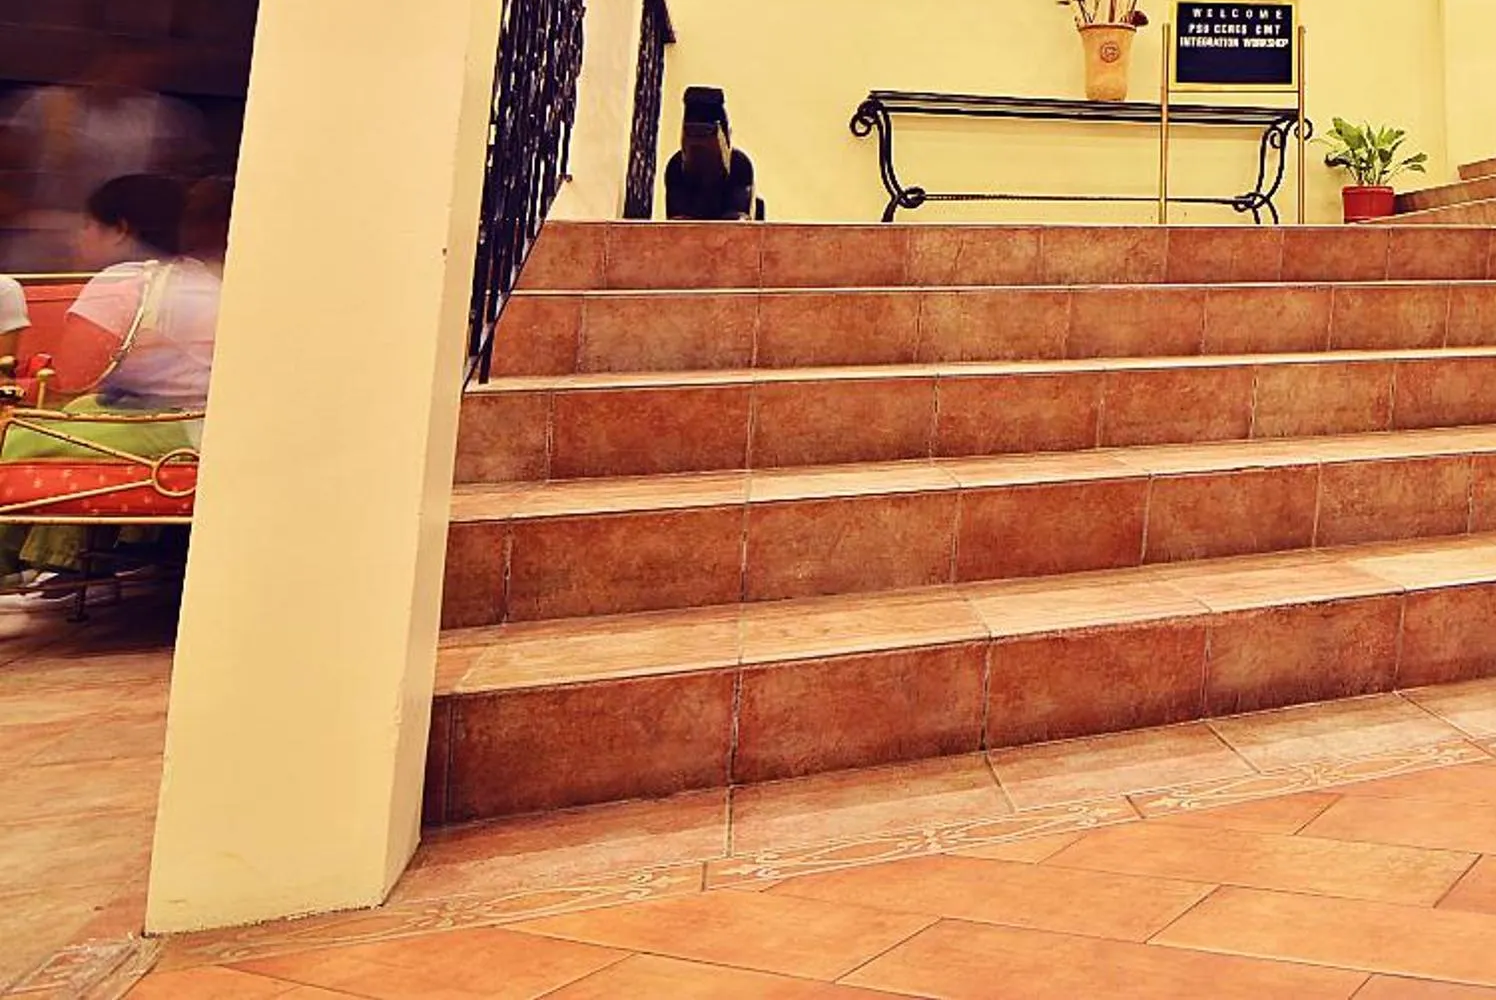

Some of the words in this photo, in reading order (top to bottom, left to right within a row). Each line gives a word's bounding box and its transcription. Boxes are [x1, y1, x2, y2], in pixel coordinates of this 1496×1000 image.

[1192, 8, 1283, 20] WELCOME
[1180, 35, 1239, 48] INTEGRATION
[1242, 37, 1289, 48] WORKSHOP
